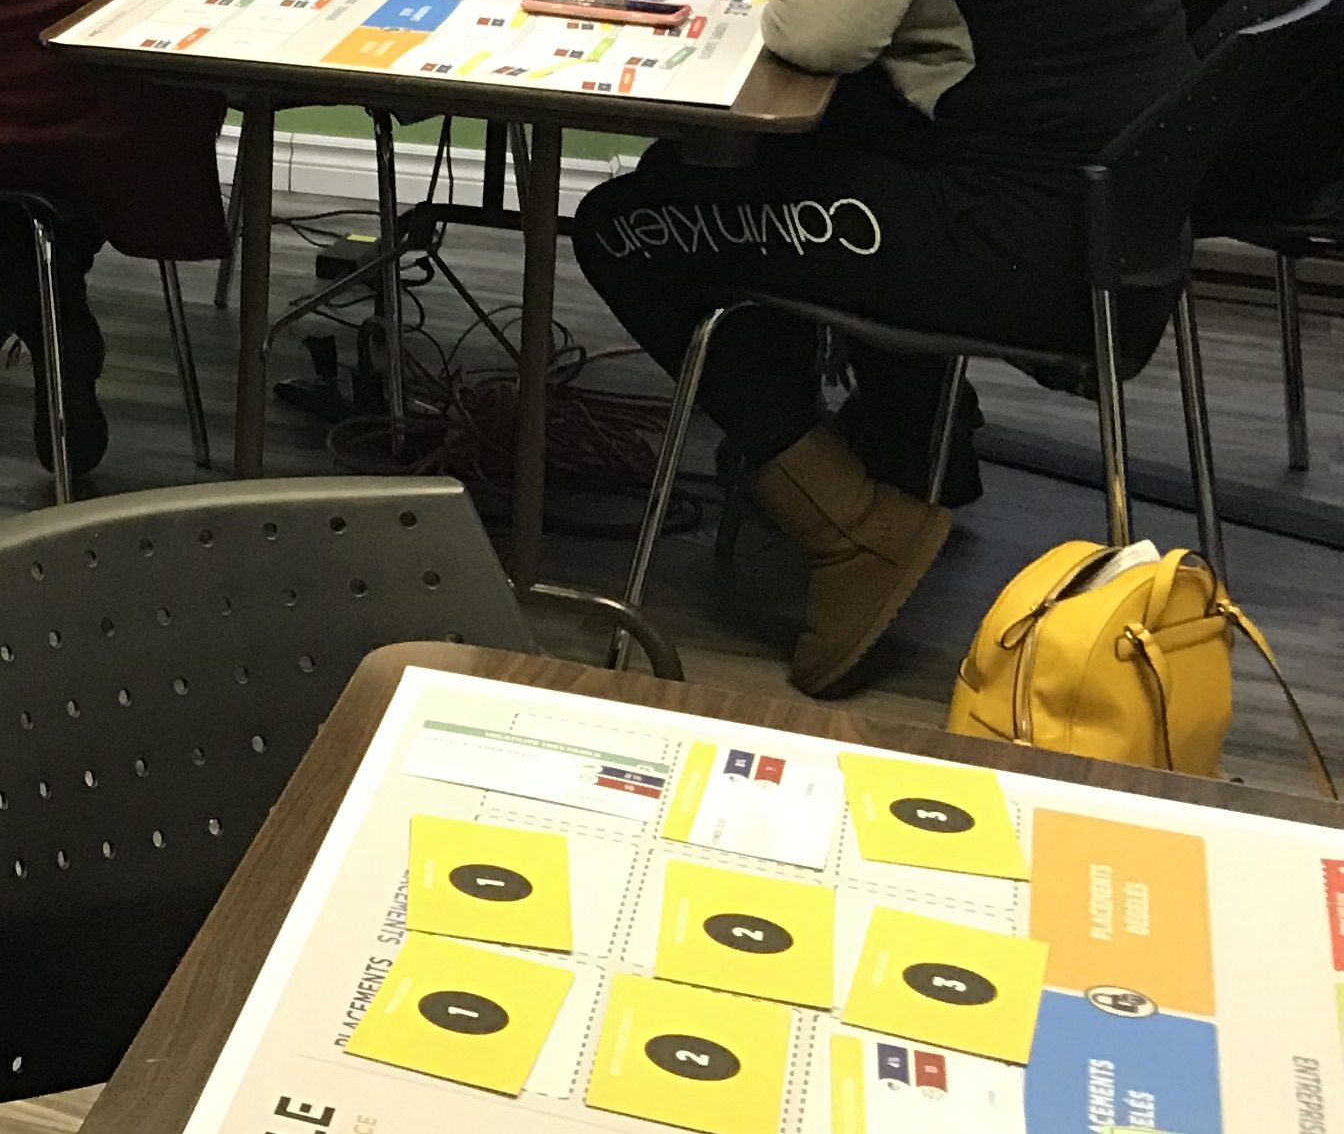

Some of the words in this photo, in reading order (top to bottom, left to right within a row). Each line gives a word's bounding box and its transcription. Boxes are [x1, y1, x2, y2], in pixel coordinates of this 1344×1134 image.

[597, 204, 720, 258] Klein
[712, 198, 881, 256] Calvin
[916, 809, 948, 821] 3
[476, 878, 505, 886] 1
[732, 926, 764, 942] 2
[932, 976, 967, 992] 3
[448, 1006, 479, 1018] 1
[675, 1049, 710, 1066] 2
[1292, 1055, 1327, 1134] ENTREPRIS
